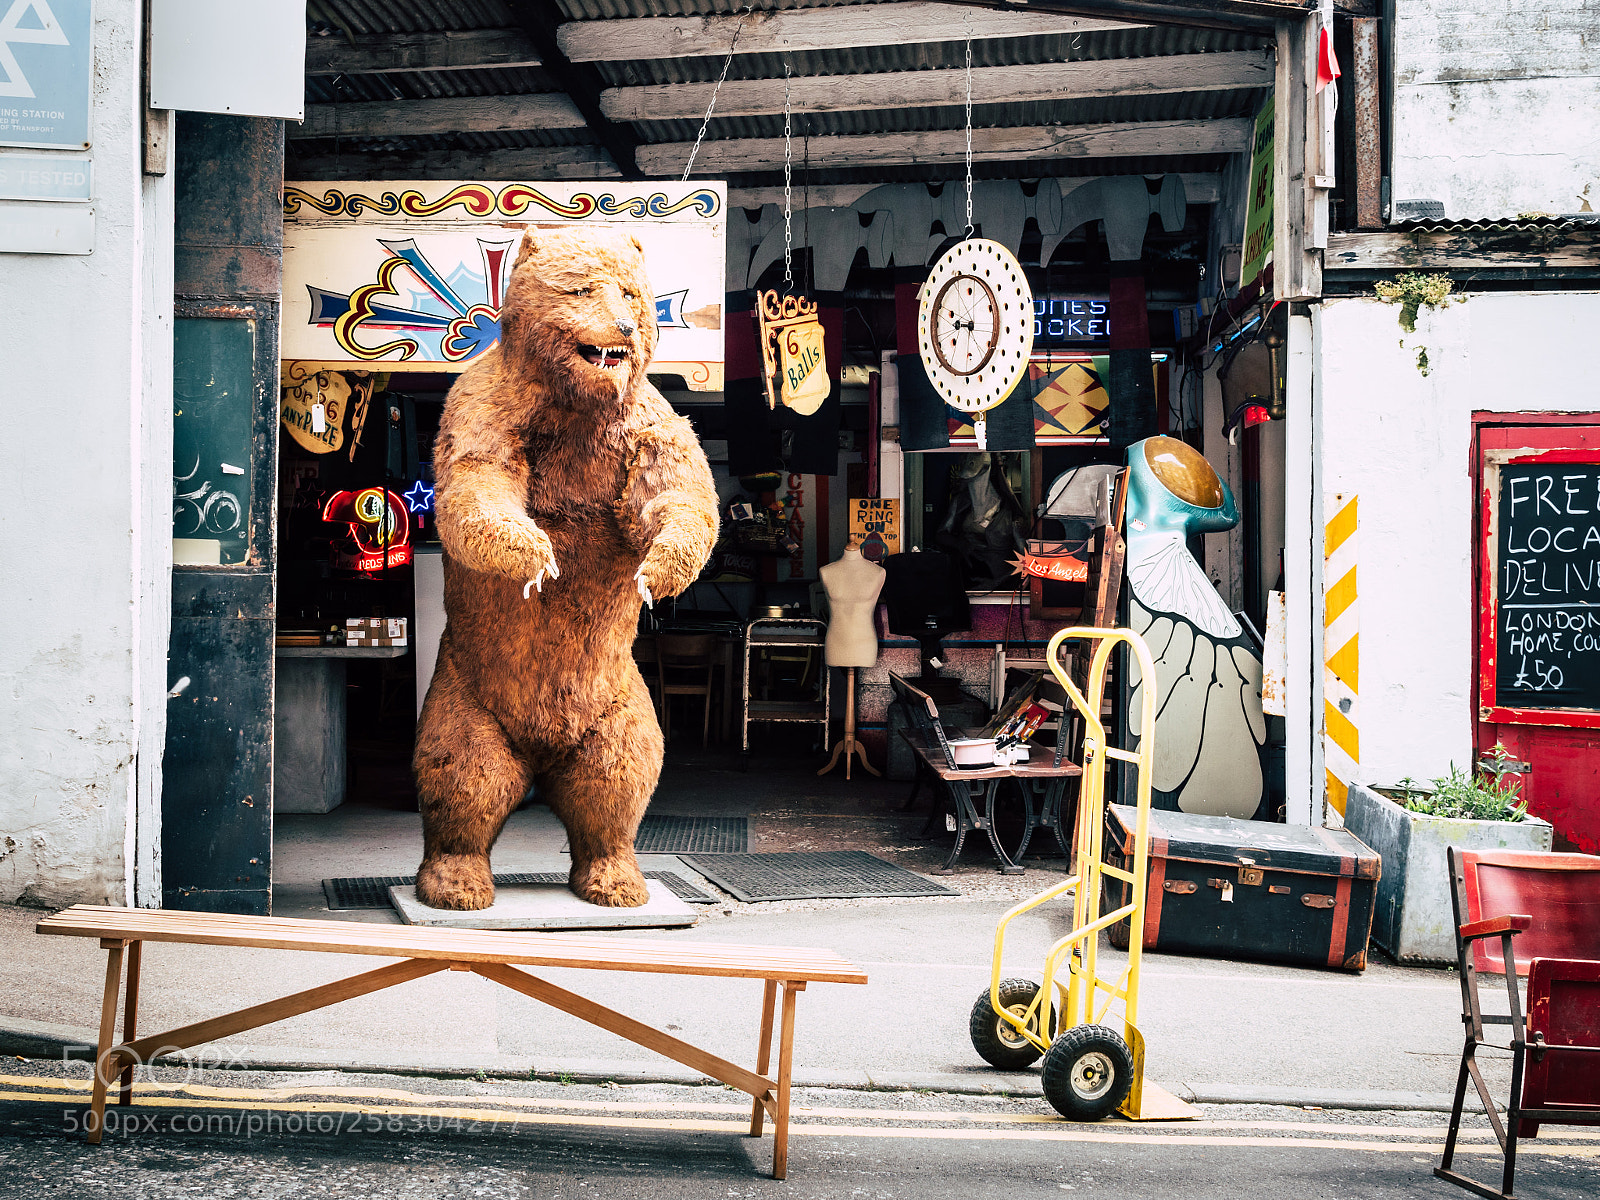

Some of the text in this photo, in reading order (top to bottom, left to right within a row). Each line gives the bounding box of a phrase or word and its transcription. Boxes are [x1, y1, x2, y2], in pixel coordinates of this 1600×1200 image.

[22, 110, 65, 120] STATION
[11, 125, 55, 133] TRANSPORT
[16, 170, 86, 186] TESTED
[786, 329, 799, 356] 6
[787, 346, 820, 391] Balls
[293, 387, 313, 403] or
[281, 406, 304, 427] ANY
[859, 499, 893, 510] ONE
[864, 521, 886, 533] ON
[883, 533, 898, 541] TOP
[1028, 558, 1049, 577] Los
[1513, 654, 1564, 691] £50
